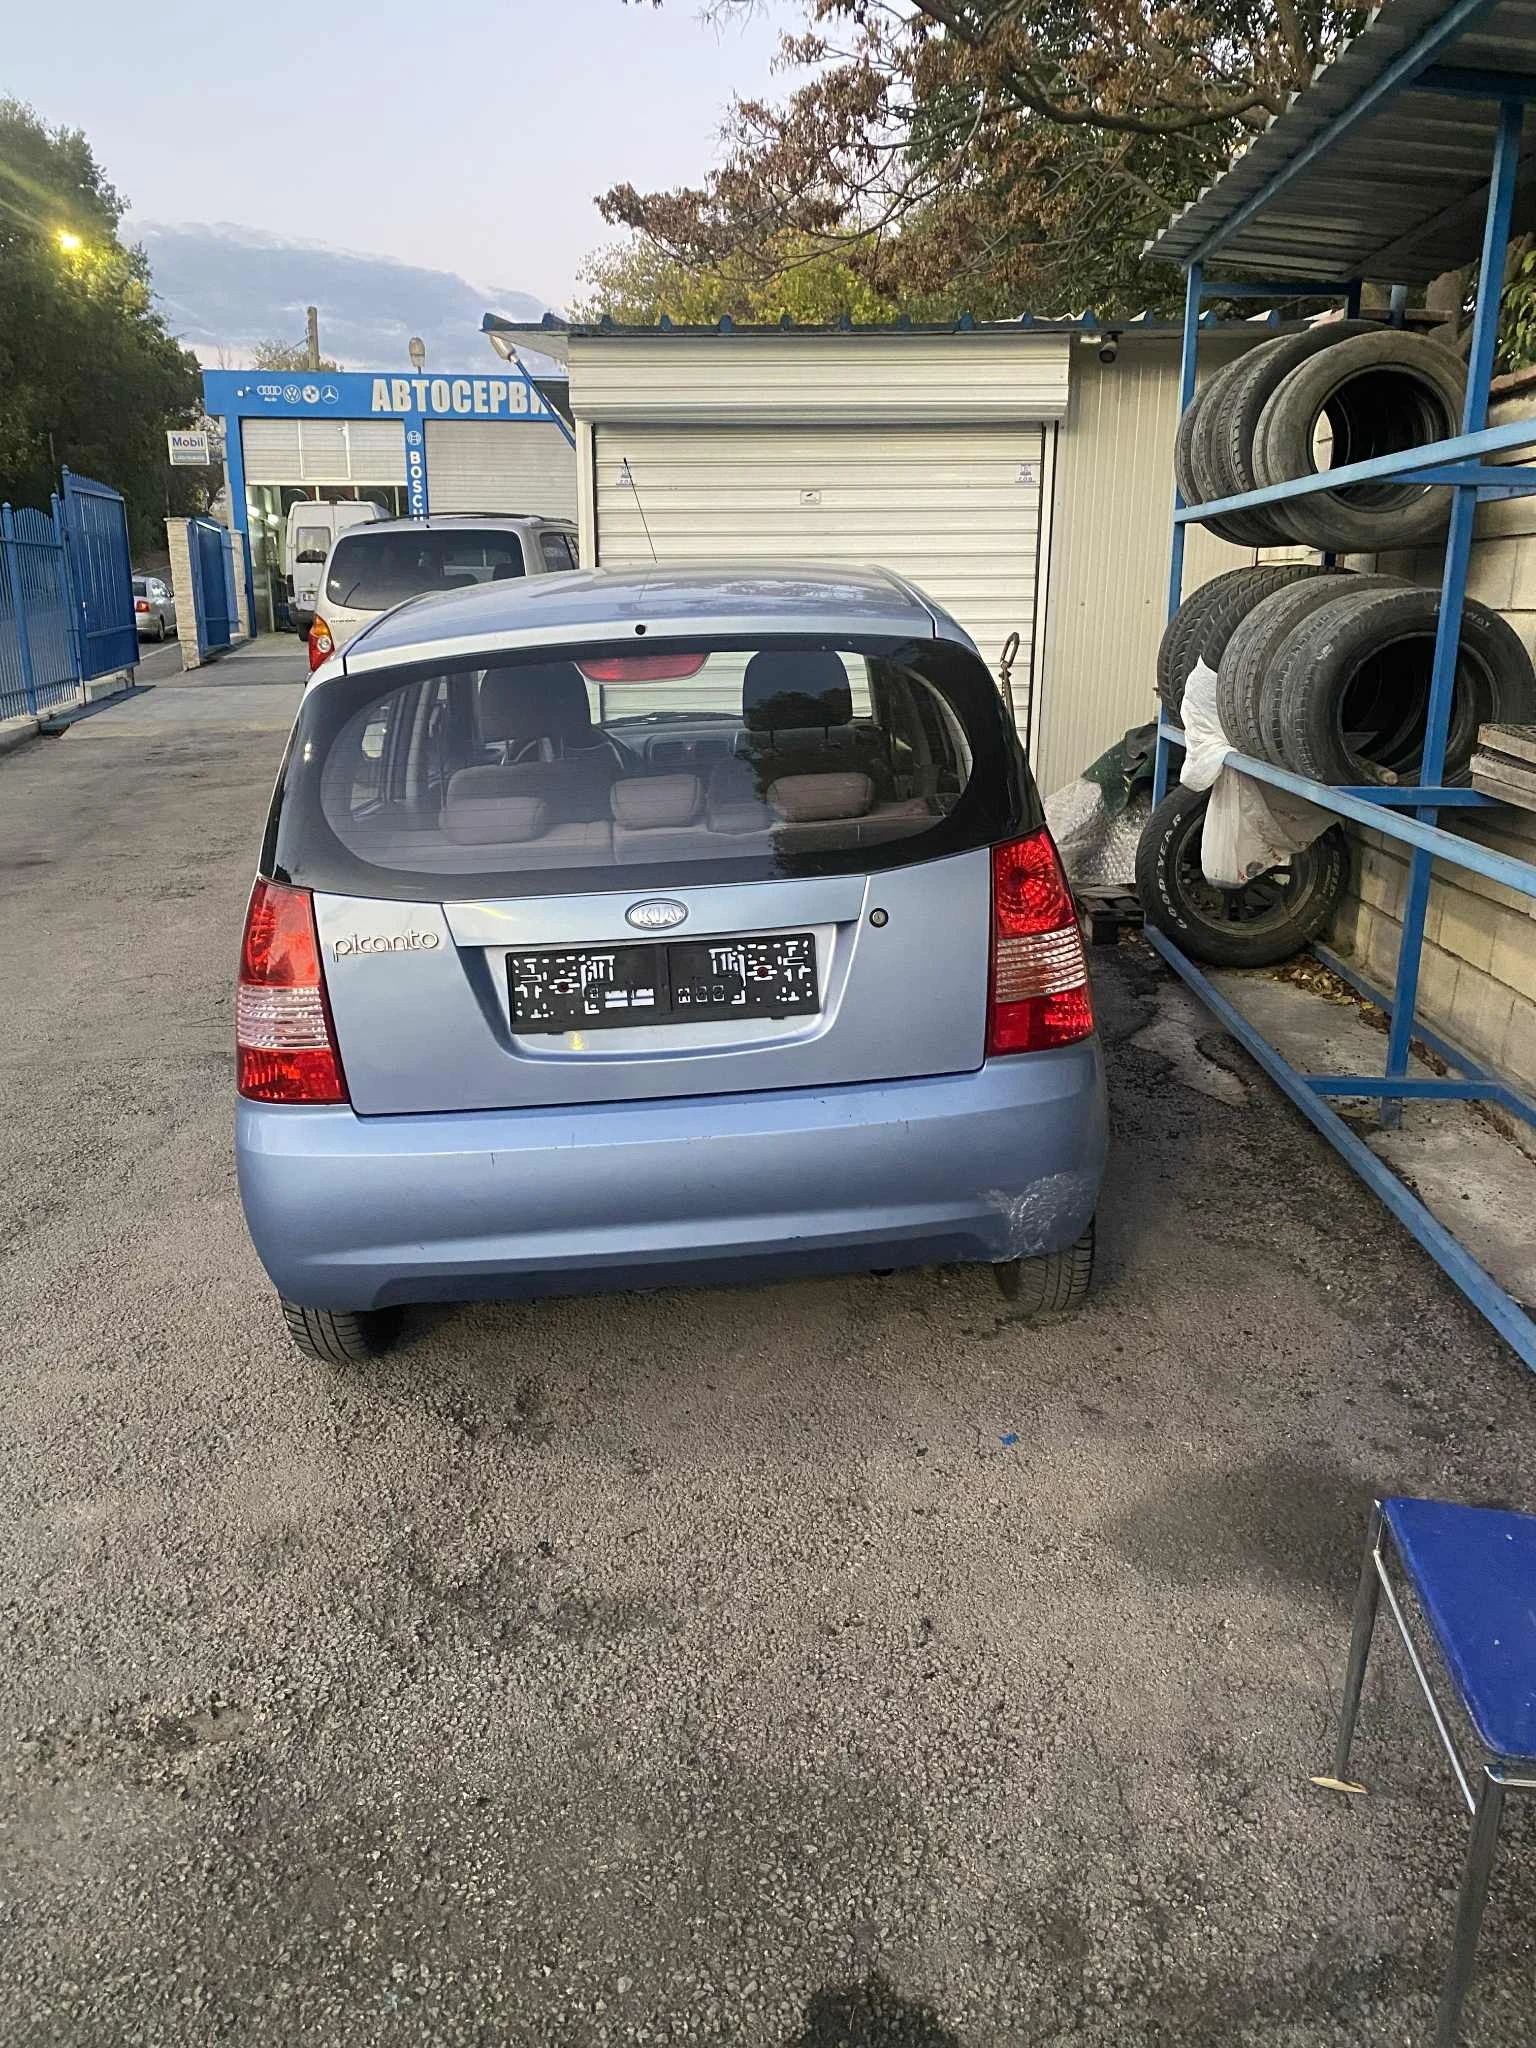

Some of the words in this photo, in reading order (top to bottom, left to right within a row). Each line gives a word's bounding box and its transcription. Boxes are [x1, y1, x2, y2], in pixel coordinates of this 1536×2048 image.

[371, 379, 549, 414] АВТОСЕРВИ
[172, 436, 203, 447] Mobil
[333, 929, 440, 963] picanto
